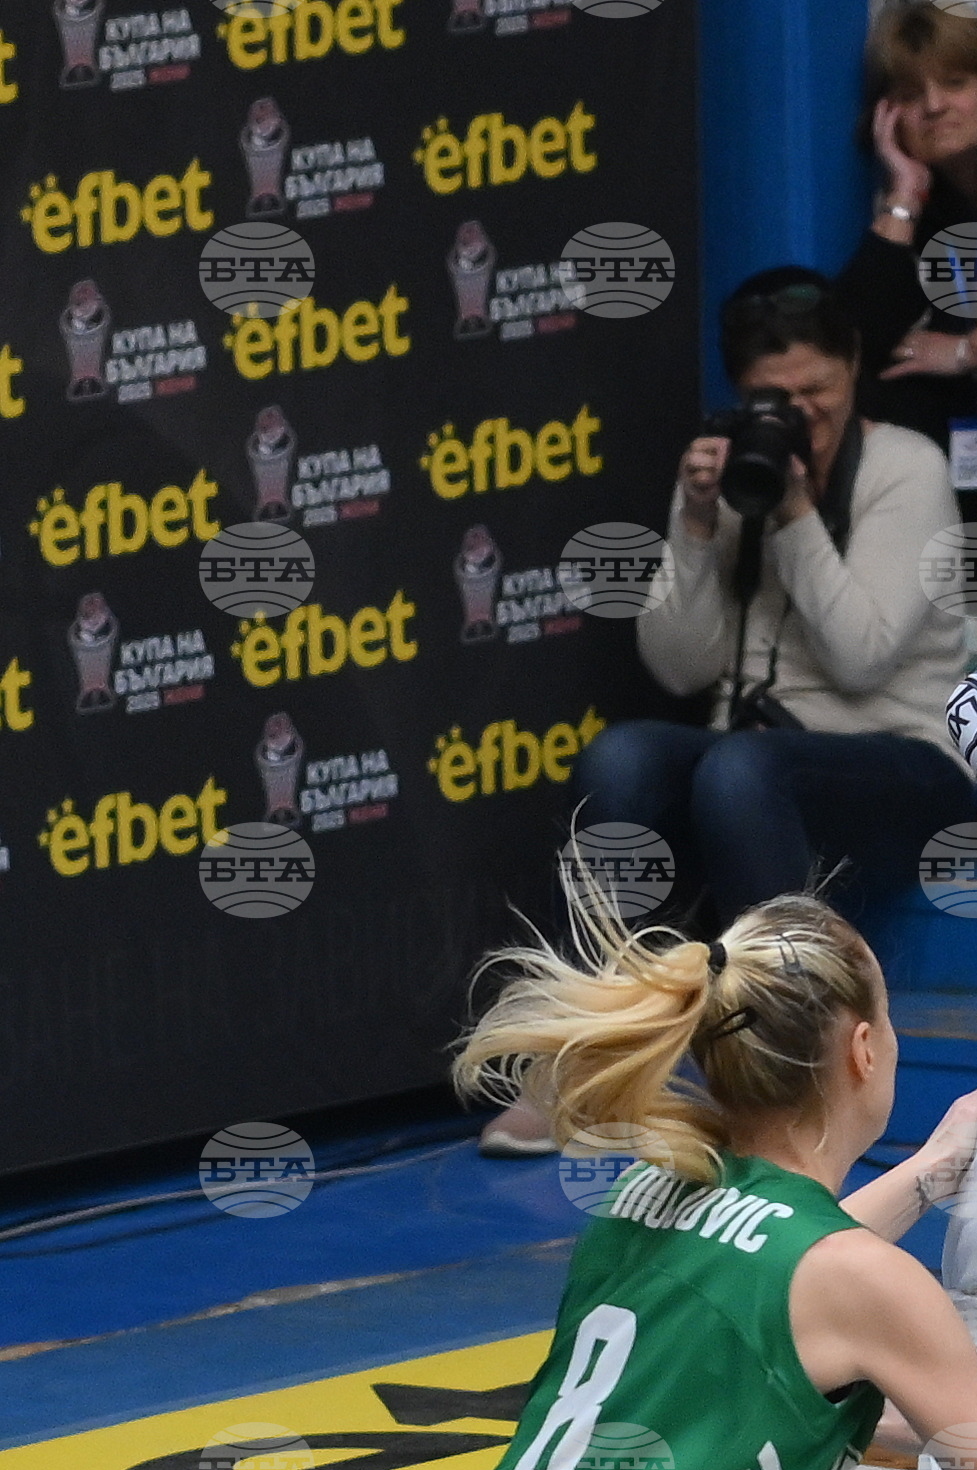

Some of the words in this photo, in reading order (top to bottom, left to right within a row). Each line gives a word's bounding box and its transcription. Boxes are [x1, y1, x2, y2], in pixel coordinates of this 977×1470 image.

[218, 0, 404, 69] efbet
[414, 102, 597, 194] efbet
[21, 158, 214, 253] efbet
[224, 285, 411, 380] efbet
[420, 404, 603, 499] efbet
[29, 469, 221, 566] efbet
[232, 590, 418, 687] efbet
[38, 776, 230, 876] efbet
